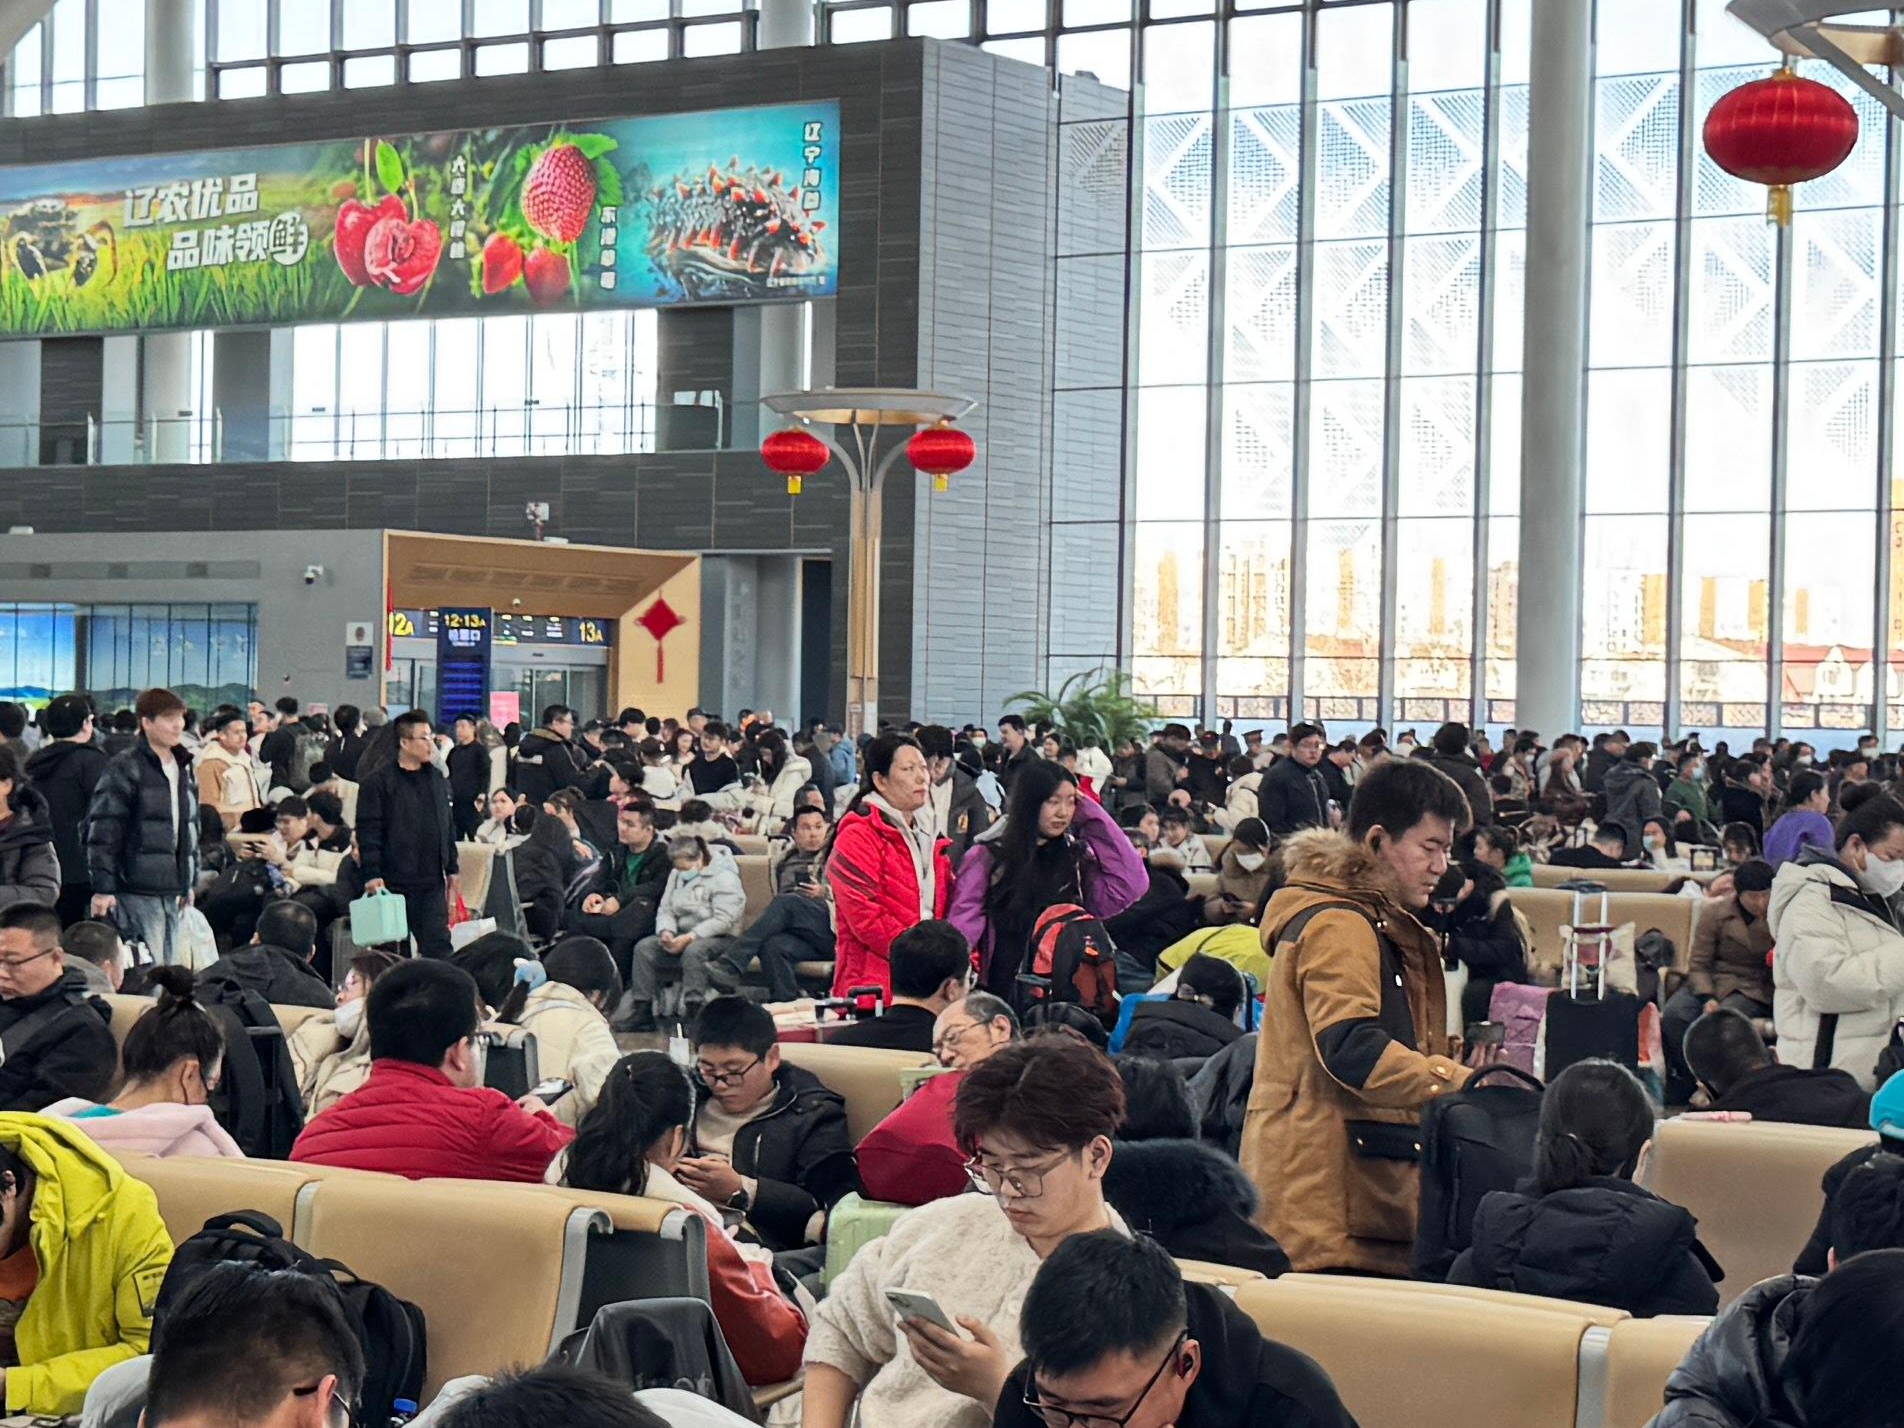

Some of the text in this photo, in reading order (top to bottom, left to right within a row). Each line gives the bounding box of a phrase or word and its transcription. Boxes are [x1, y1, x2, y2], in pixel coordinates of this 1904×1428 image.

[123, 173, 259, 228] 辽农优品
[167, 211, 309, 270] 品味领鲜
